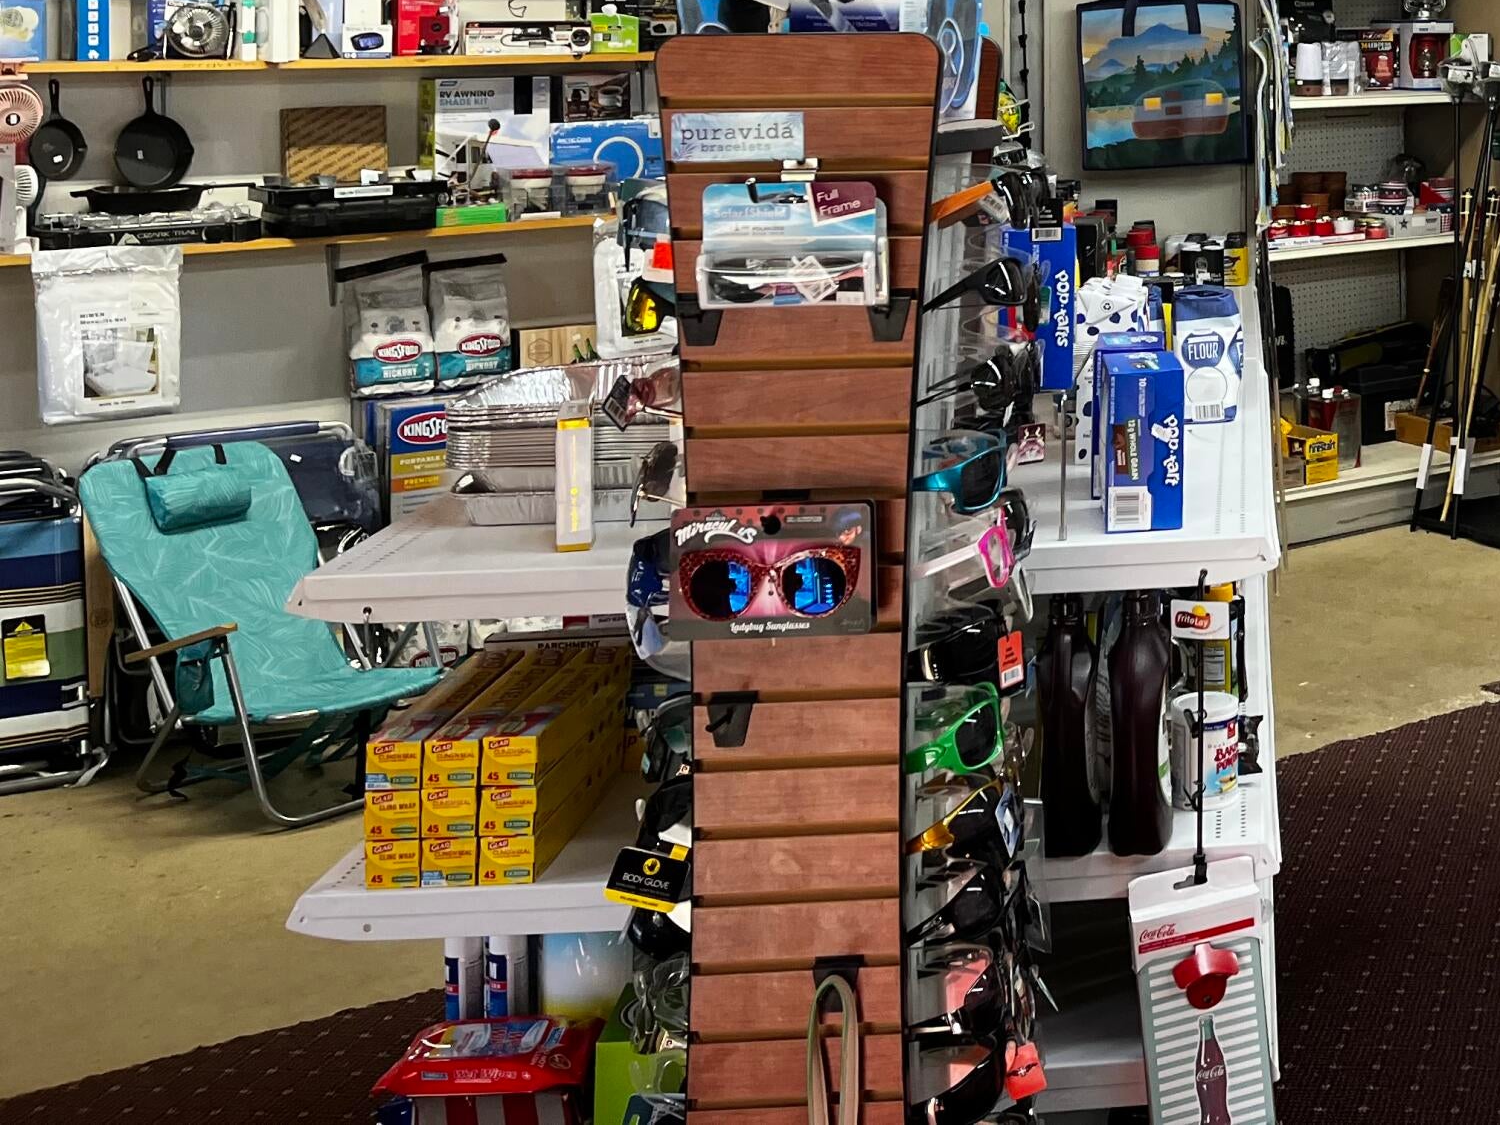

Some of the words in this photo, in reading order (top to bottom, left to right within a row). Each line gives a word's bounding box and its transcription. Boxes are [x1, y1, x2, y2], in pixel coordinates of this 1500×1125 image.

[439, 90, 451, 98] RV
[454, 89, 496, 98] AWNING
[439, 98, 472, 106] SHADE
[473, 98, 489, 106] KIT
[700, 141, 771, 153] bracelets
[816, 191, 839, 204] Full
[818, 198, 862, 216] Frame
[172, 229, 199, 238] TRAIL
[1187, 341, 1219, 361] FLOUR
[730, 622, 764, 633] Ladybug
[766, 621, 810, 632] Sunglasses
[537, 640, 600, 650] PARCHMENT
[427, 774, 440, 783] 45
[487, 772, 500, 780] 45
[426, 824, 440, 833] 45
[484, 821, 496, 830] 45
[370, 826, 383, 835] 45
[371, 875, 383, 883] 45
[484, 871, 496, 879] 45
[622, 872, 644, 884] BODY
[643, 877, 670, 890] GLOVE
